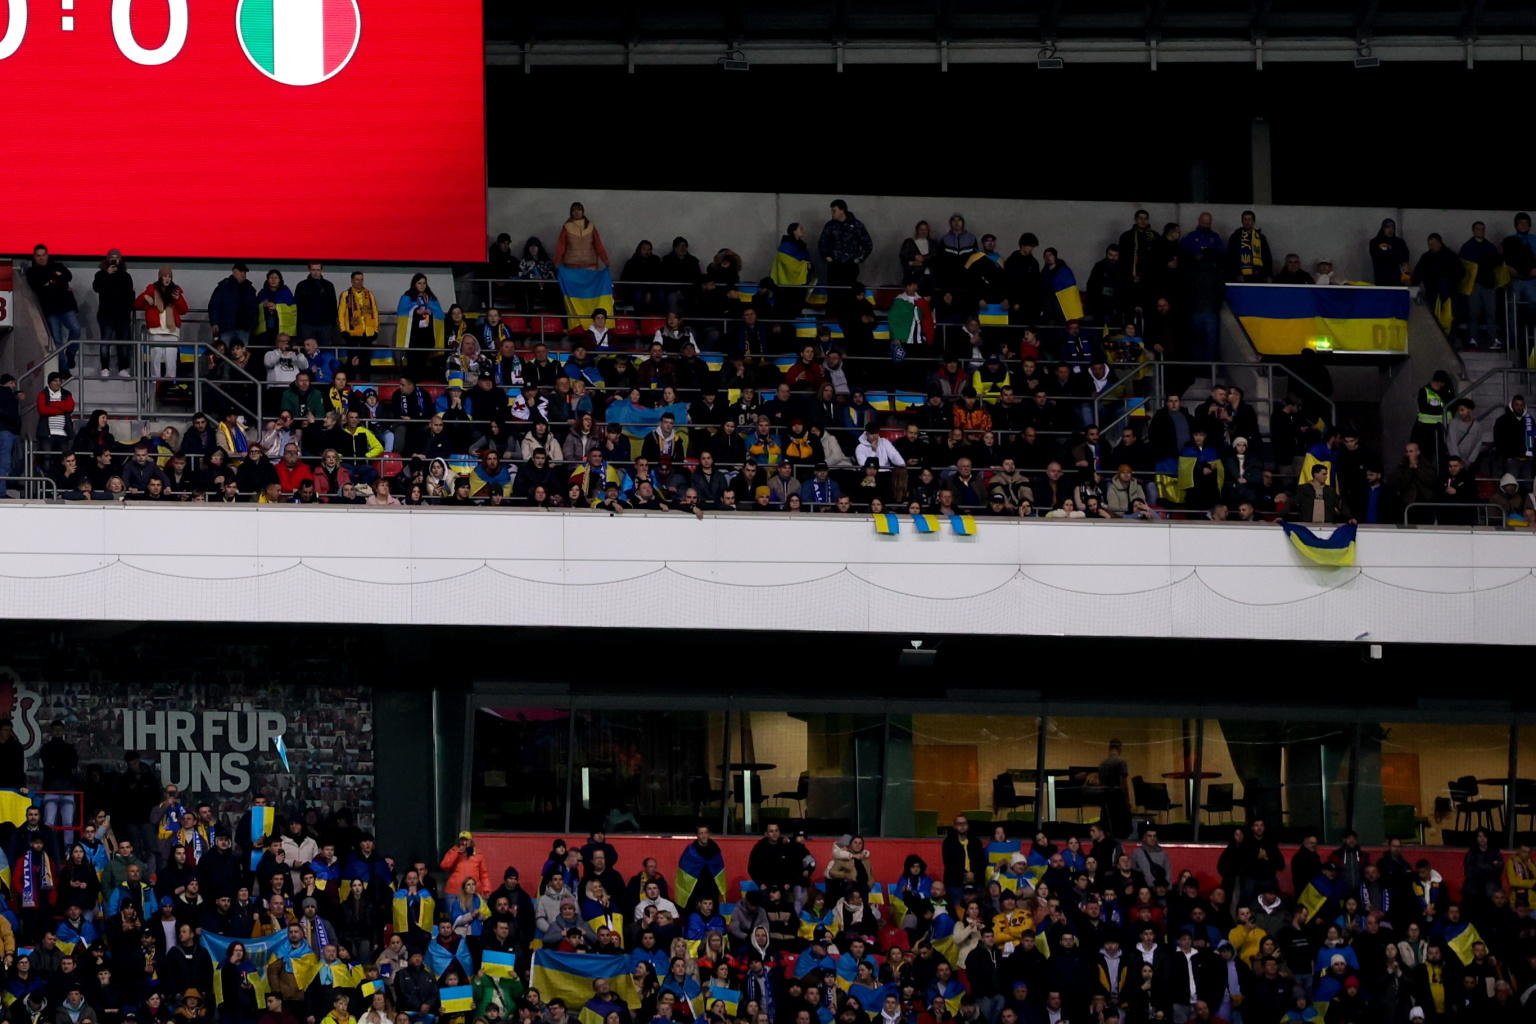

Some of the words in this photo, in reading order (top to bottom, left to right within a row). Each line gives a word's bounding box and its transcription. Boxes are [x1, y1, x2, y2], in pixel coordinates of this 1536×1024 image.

[122, 710, 198, 752] IHR
[202, 703, 287, 752] FÜR
[160, 752, 252, 794] UNS
